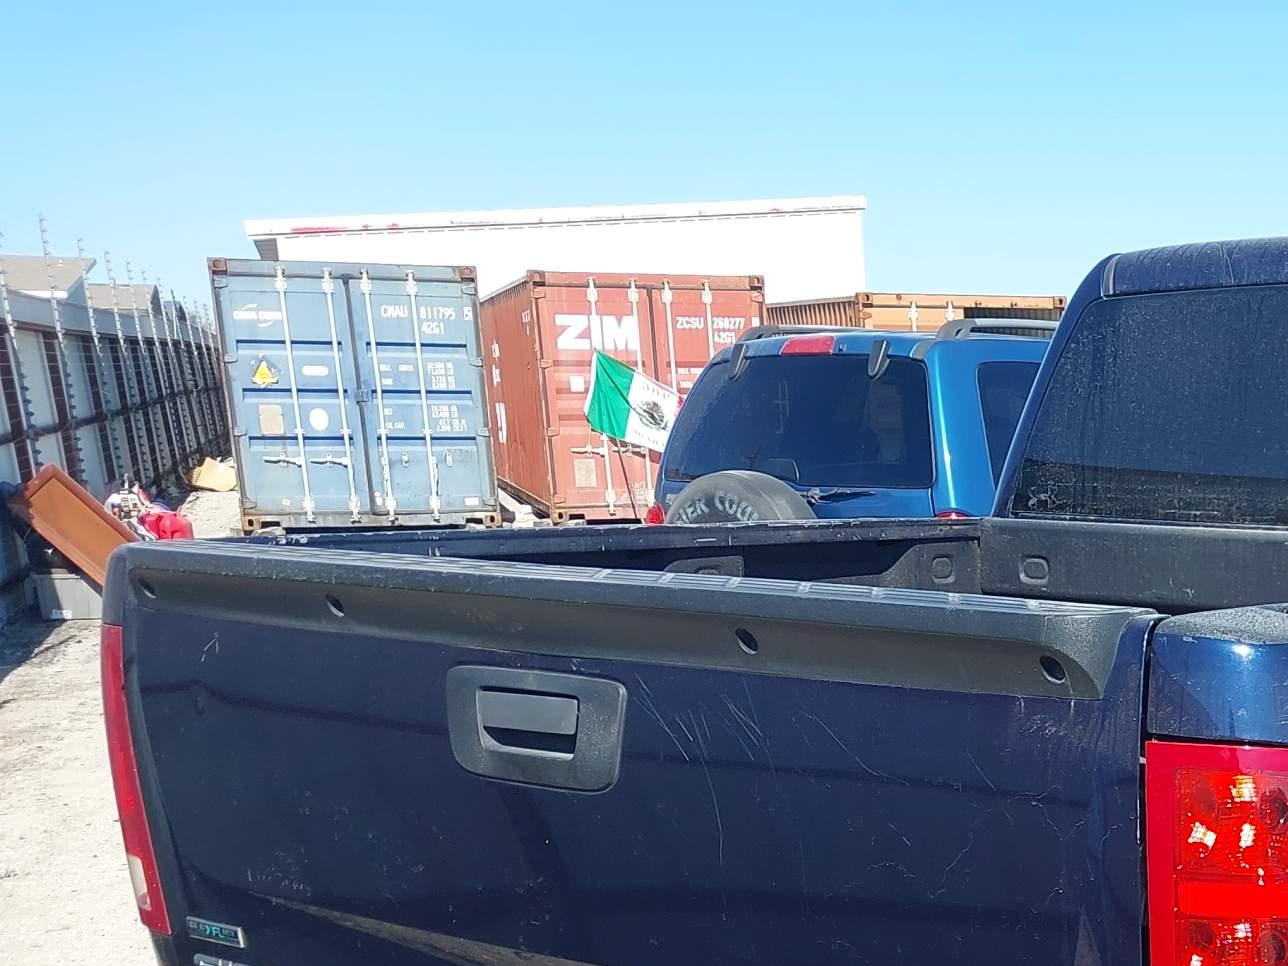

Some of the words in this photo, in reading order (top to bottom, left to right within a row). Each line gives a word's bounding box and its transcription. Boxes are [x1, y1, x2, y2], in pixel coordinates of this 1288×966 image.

[419, 306, 456, 320] 811795
[675, 316, 705, 330] ZCSU
[554, 314, 639, 350] ZIM
